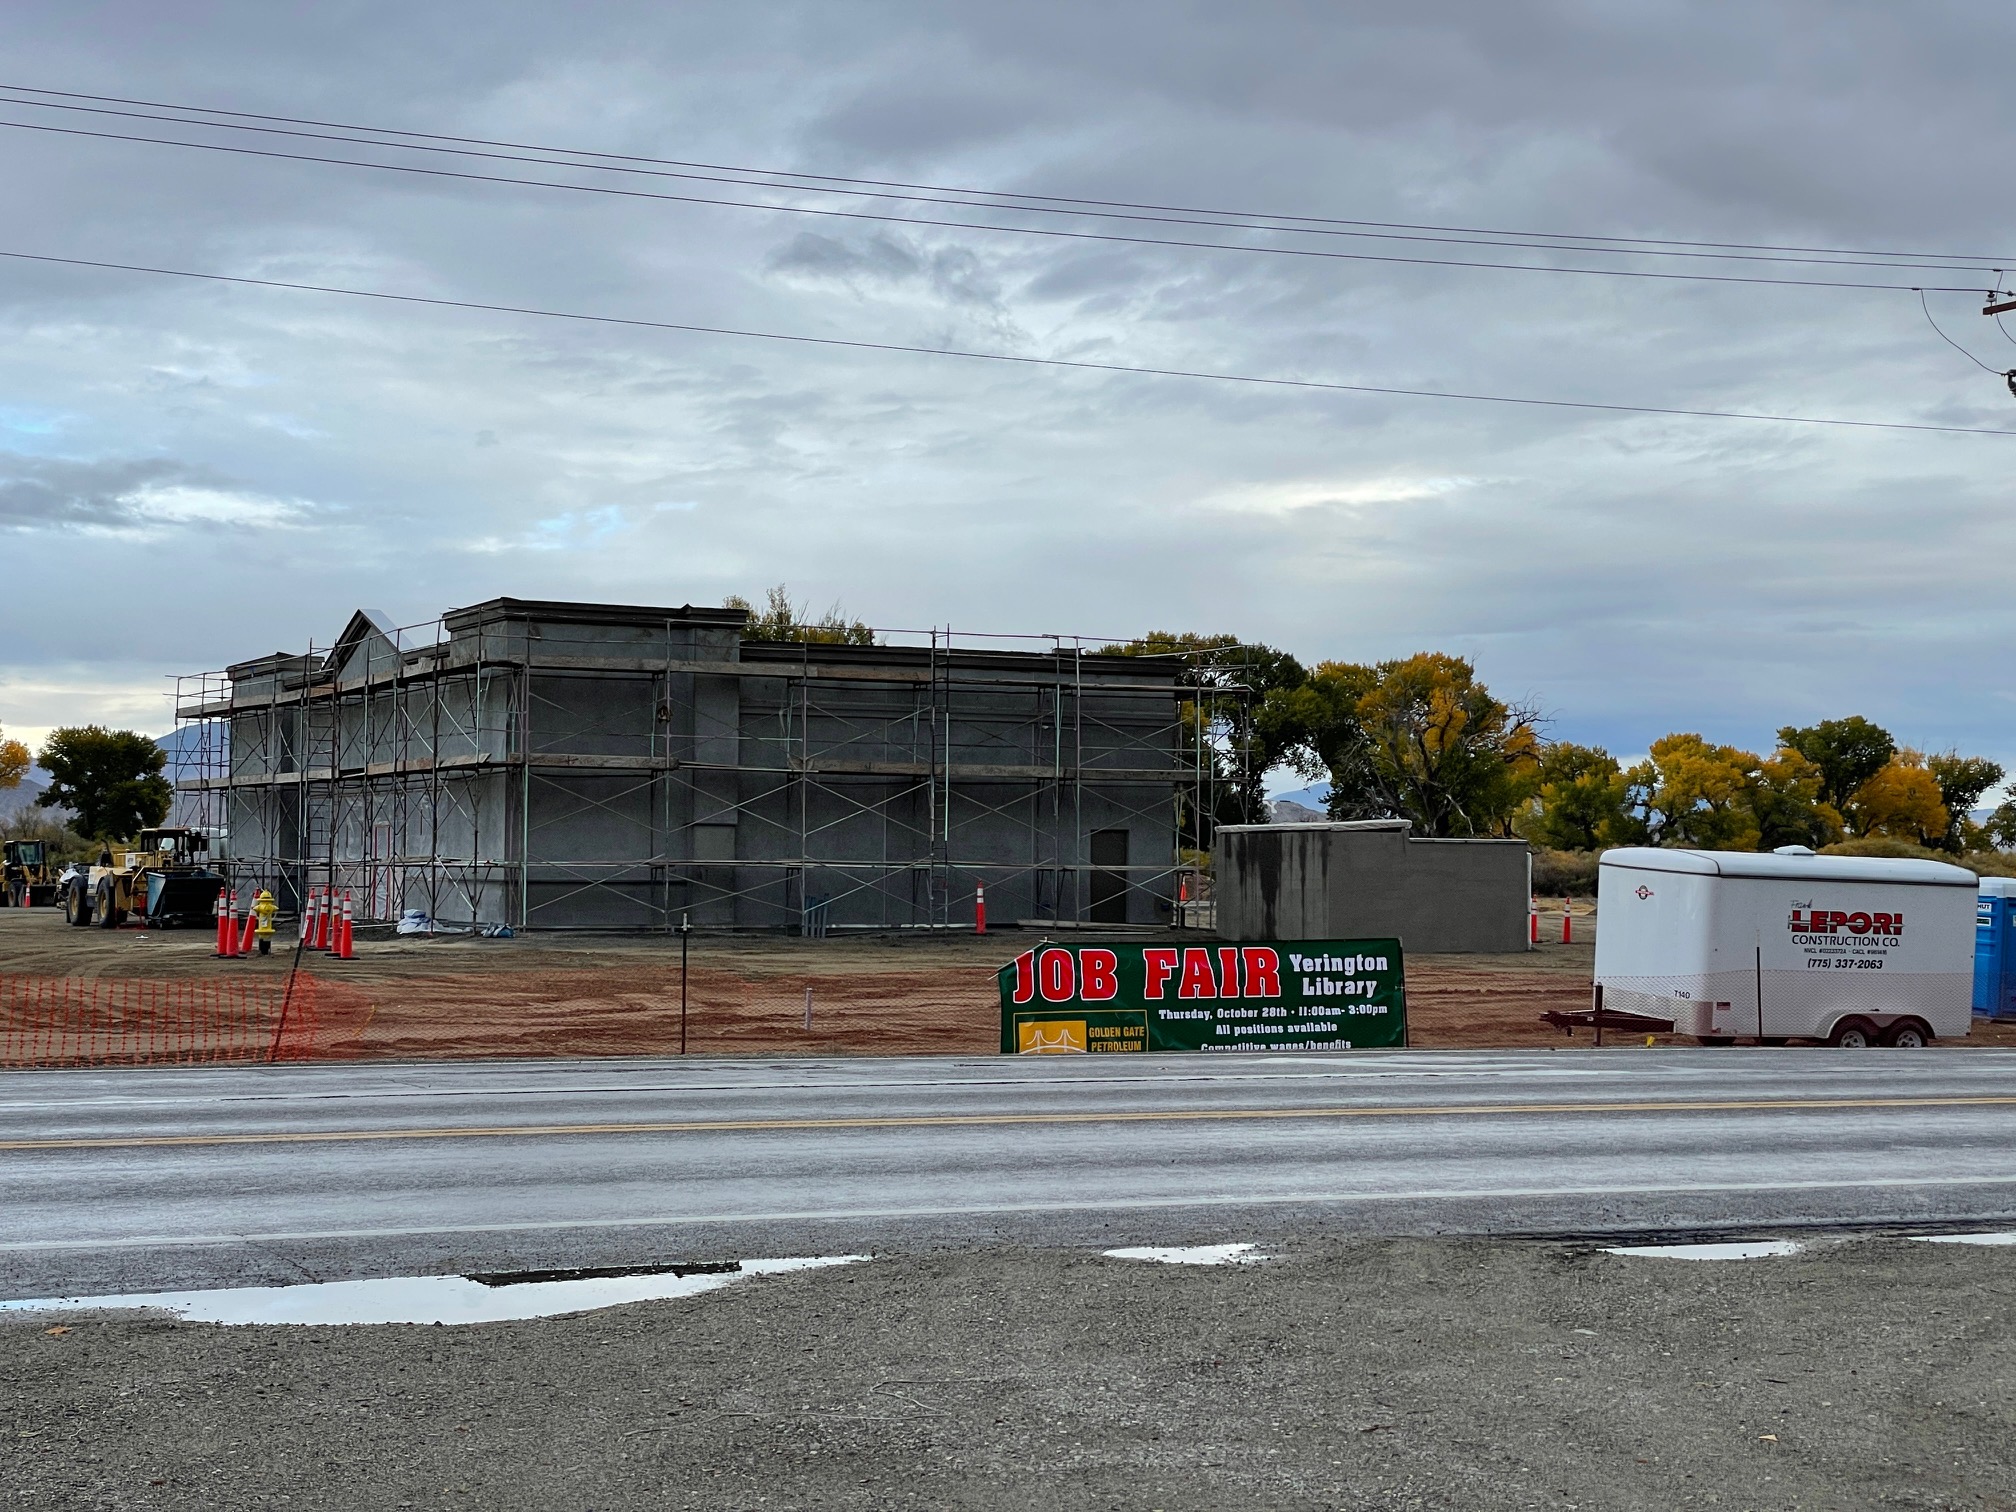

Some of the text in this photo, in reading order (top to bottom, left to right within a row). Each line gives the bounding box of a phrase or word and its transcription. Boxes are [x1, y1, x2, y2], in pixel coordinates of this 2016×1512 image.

[1791, 909, 1903, 936] LEPORI
[1791, 935, 1901, 947] CONSTRUCTION CO.
[1289, 954, 1388, 976] Yerington
[1807, 957, 1832, 969] (775)
[1013, 946, 1281, 1003] JOB FAIR
[1302, 976, 1378, 998] Library
[1158, 1009, 1213, 1020] Thursday,
[1216, 1007, 1259, 1019] October
[1261, 1006, 1287, 1018] 28th
[1348, 1004, 1388, 1017] 3:00pm
[1088, 1025, 1145, 1038] GOLDEN GATE
[1215, 1021, 1338, 1036] All positions available
[1091, 1040, 1142, 1052] PETROLEUM
